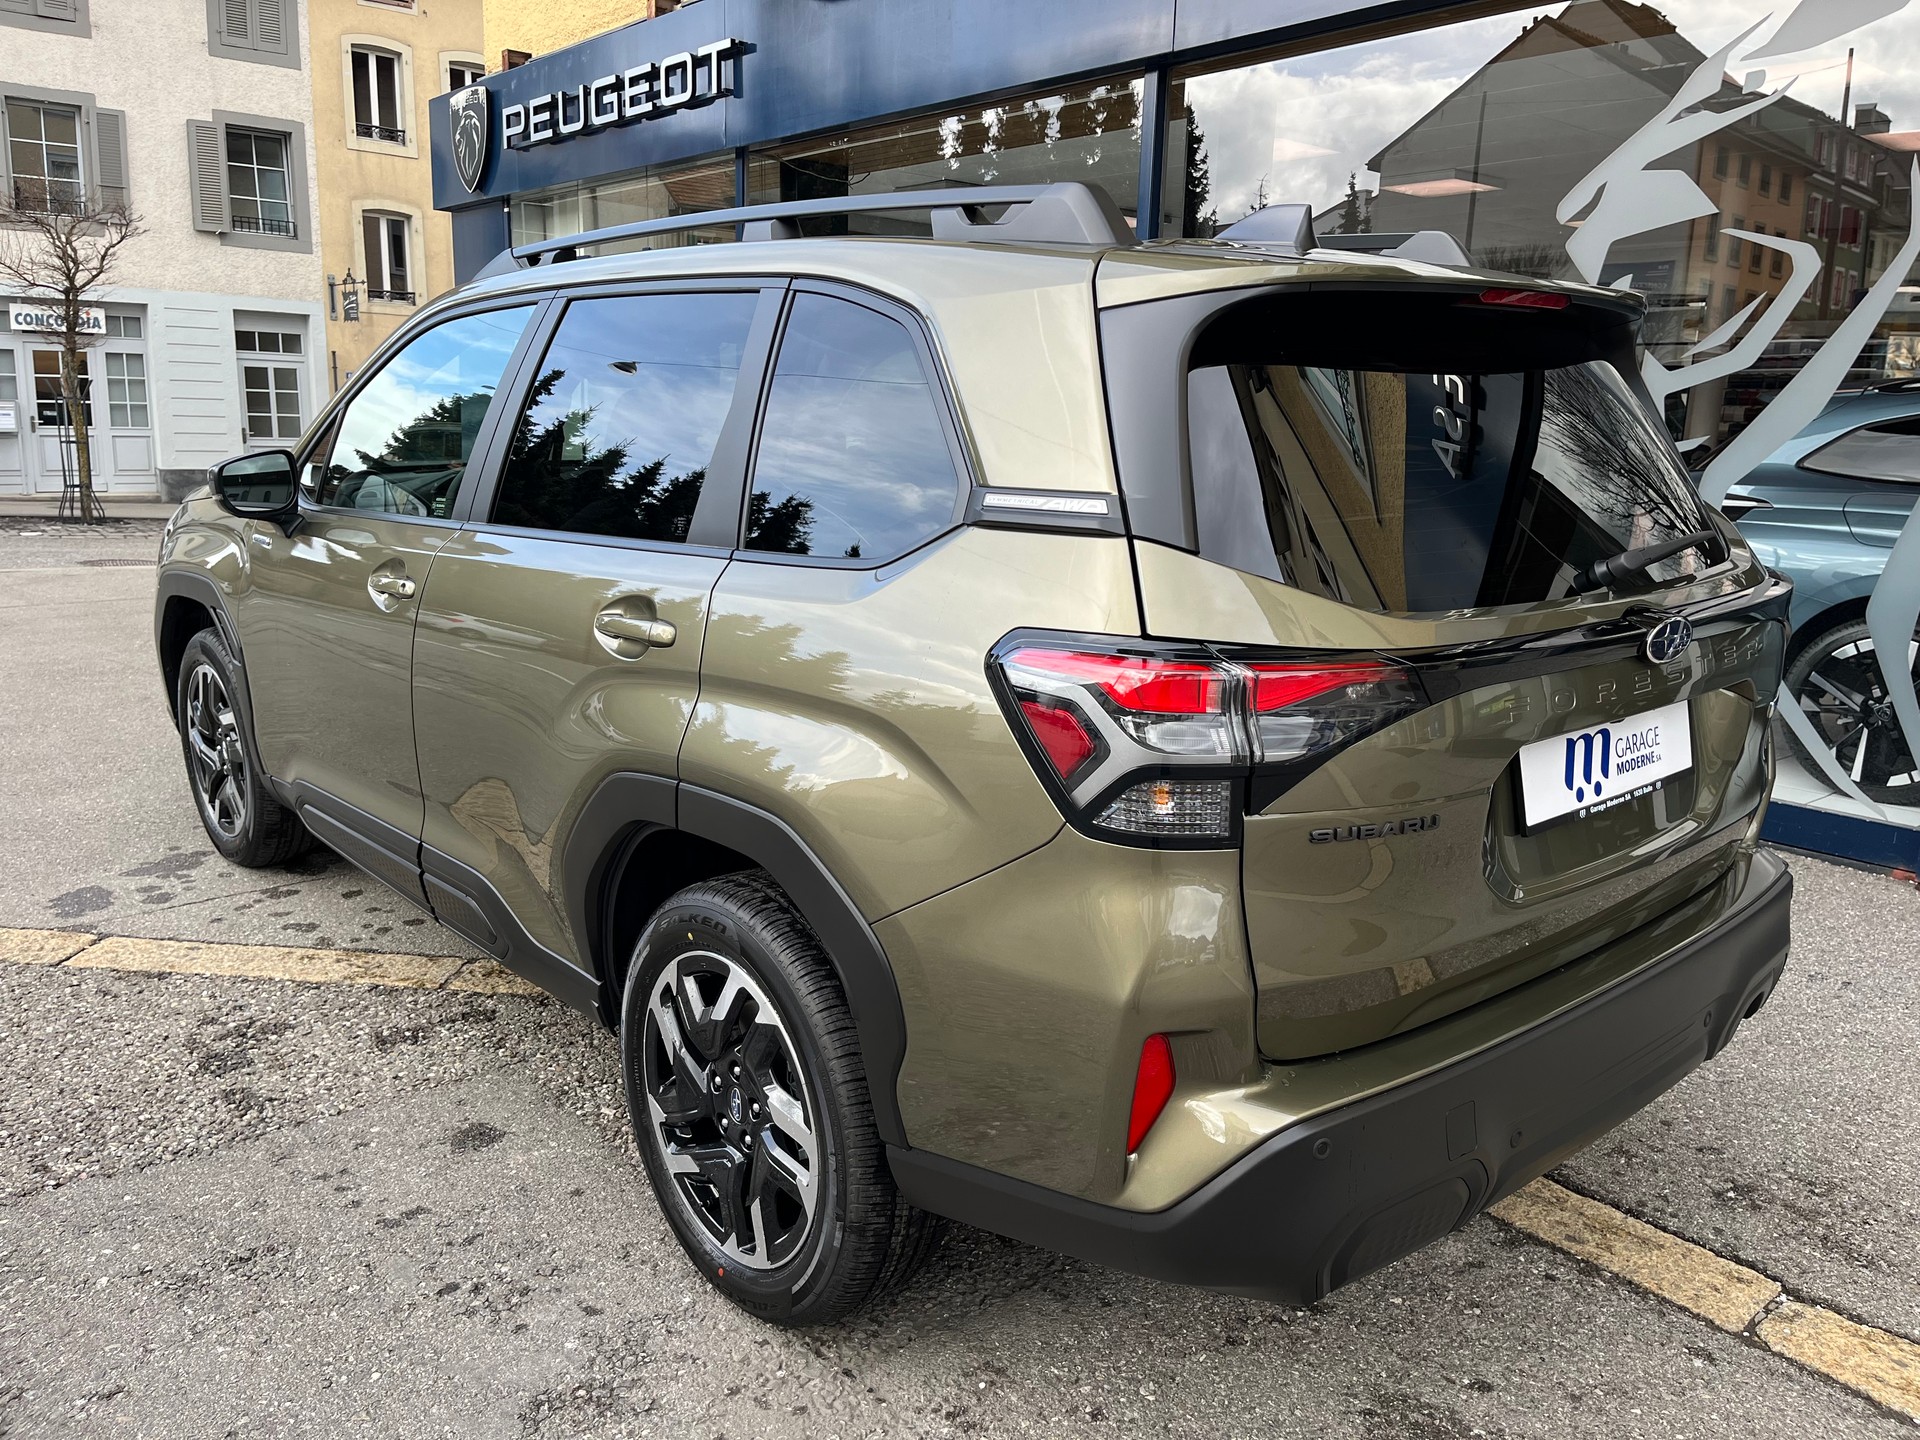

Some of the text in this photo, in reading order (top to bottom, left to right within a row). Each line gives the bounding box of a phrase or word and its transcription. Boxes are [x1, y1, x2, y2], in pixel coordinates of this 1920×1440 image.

[502, 37, 735, 150] PEUGEOT
[14, 309, 102, 329] CONCODIA
[1615, 726, 1660, 758] GARAGE
[1616, 751, 1656, 776] MODERNE
[1308, 813, 1441, 845] SUBARU
